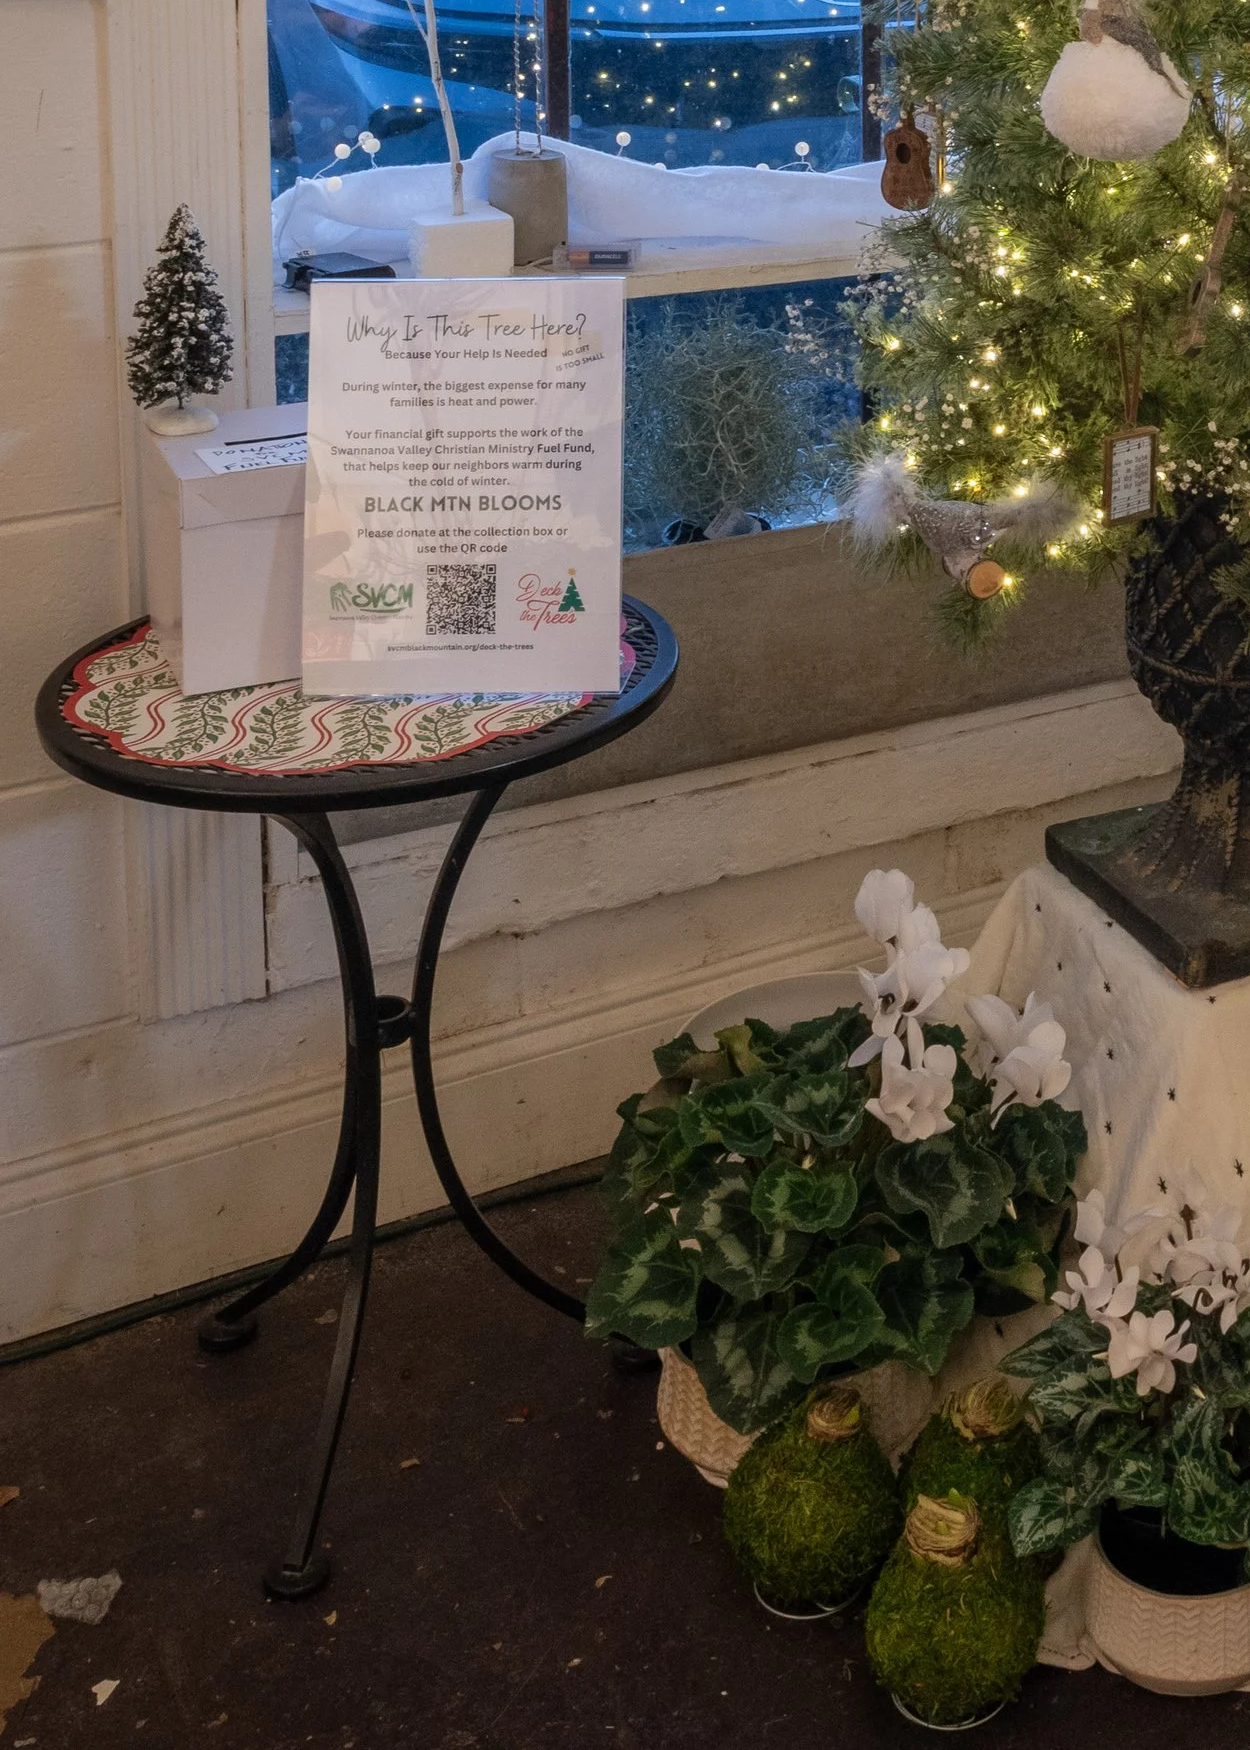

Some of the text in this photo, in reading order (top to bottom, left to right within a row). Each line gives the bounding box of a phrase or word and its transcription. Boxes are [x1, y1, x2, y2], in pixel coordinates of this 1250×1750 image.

[347, 313, 587, 352] Why Is This Tree Here?
[385, 348, 548, 360] Because Your Help Is Needed
[574, 344, 590, 355] GIFT
[564, 360, 581, 370] TOO
[582, 352, 605, 366] SMALL
[342, 380, 586, 394] During winter, the biggest expense for many
[390, 396, 537, 409] families is heat and power.
[345, 427, 583, 441] Your financial gift supports the work of the
[330, 443, 595, 457] Swannanoa Valley Christian Ministry Fuel Fund,
[343, 459, 582, 473] that helps keep our neighbors warm during
[409, 476, 510, 487] the cold of winter.
[364, 495, 562, 513] BLACK MTN BLOOMS
[357, 526, 569, 539] Please donate at the collection box or
[417, 543, 508, 554] use the QR code
[516, 573, 562, 602] Deck
[351, 582, 413, 608] SVCM
[520, 600, 577, 631] the Trees
